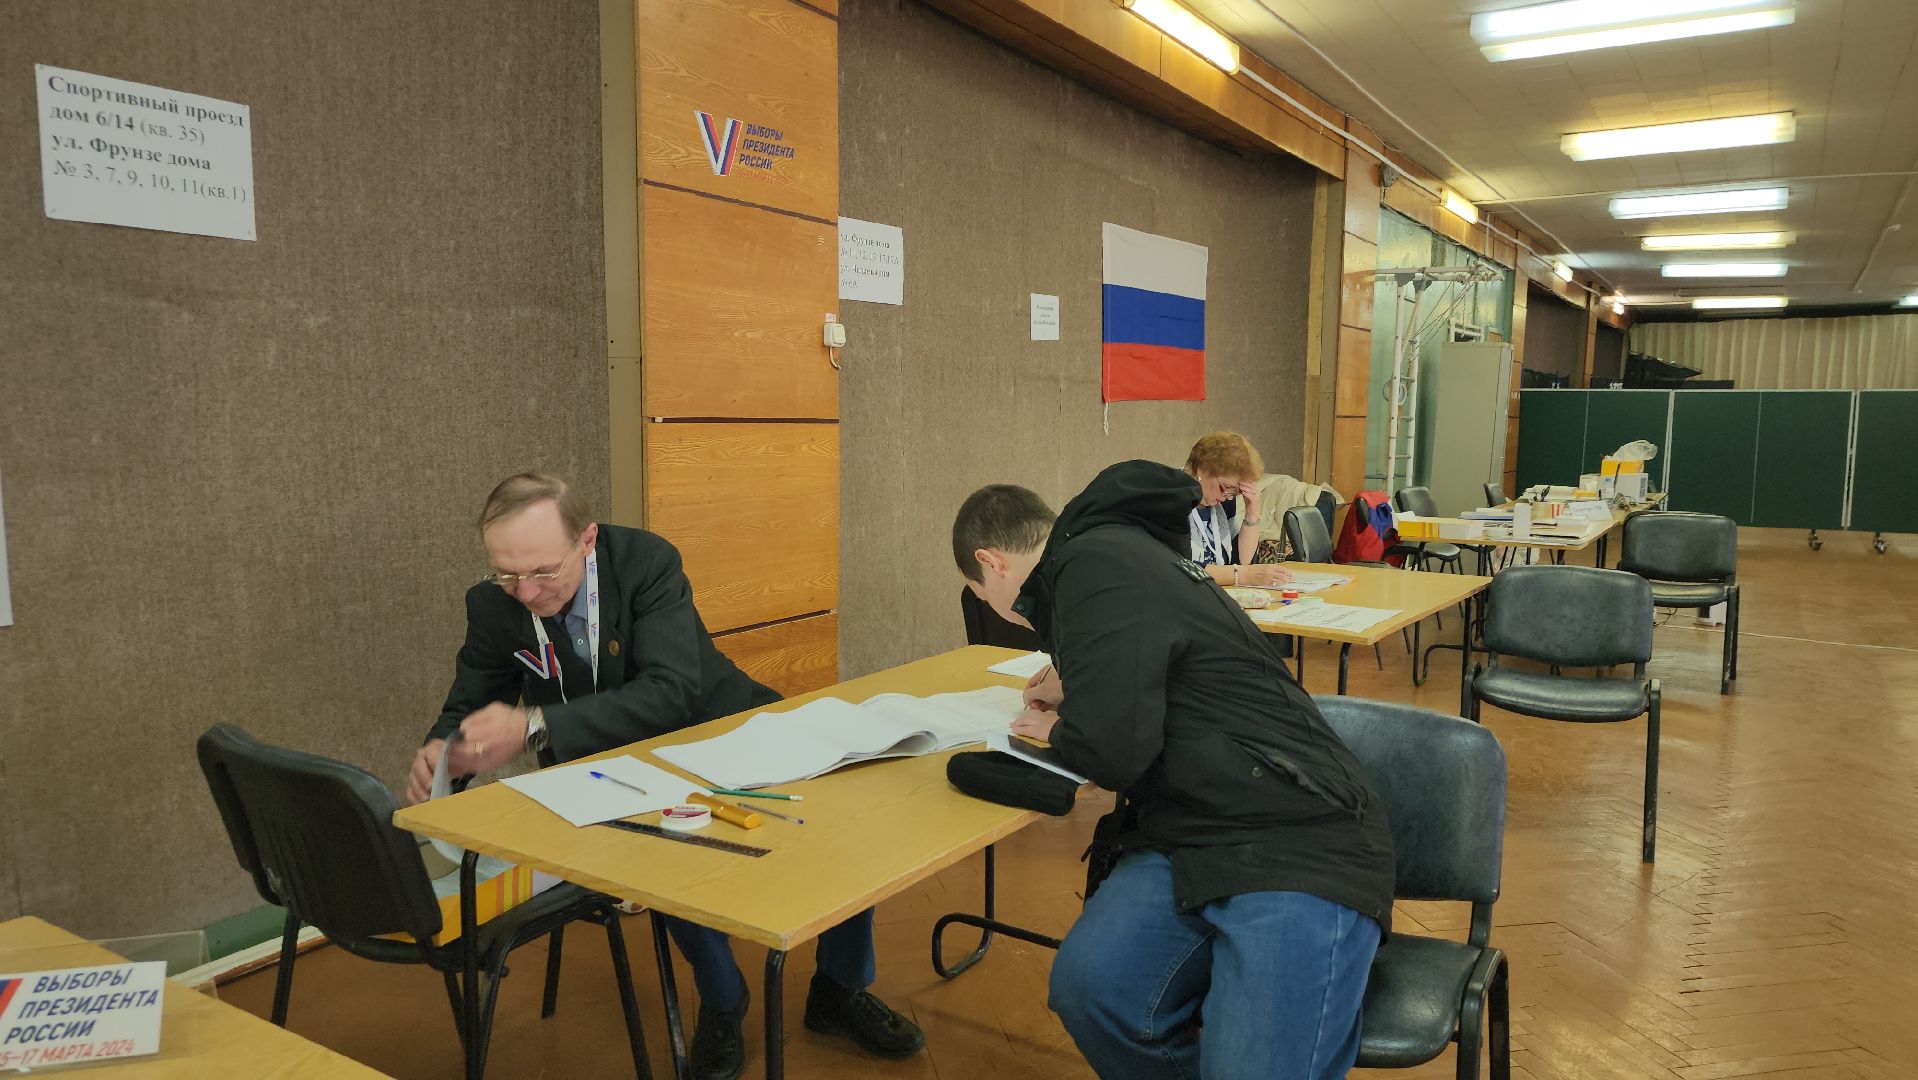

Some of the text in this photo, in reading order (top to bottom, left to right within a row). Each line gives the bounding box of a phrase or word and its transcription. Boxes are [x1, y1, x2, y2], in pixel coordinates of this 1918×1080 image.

[48, 75, 245, 128] Спортивный проезд
[49, 106, 205, 145] дом 6/14 (кв. 35)
[746, 123, 784, 141] ВЫБОРЫ
[51, 134, 211, 171] ул. Фрунзе дома
[739, 153, 773, 170] РОССИИ
[742, 138, 795, 159] ПРЕЗИДЕНТА
[53, 160, 77, 177] №
[83, 163, 100, 181] 3,
[106, 166, 121, 184] 7,
[127, 170, 143, 188] 9,
[151, 174, 175, 192] 10,
[32, 968, 134, 994] ВЫБОРЫ
[18, 988, 159, 1020] ПРЕЗИДЕНТА
[3, 1020, 97, 1045] РОССИИ
[39, 1043, 94, 1063] МАРТА
[96, 1038, 136, 1057] 2024
